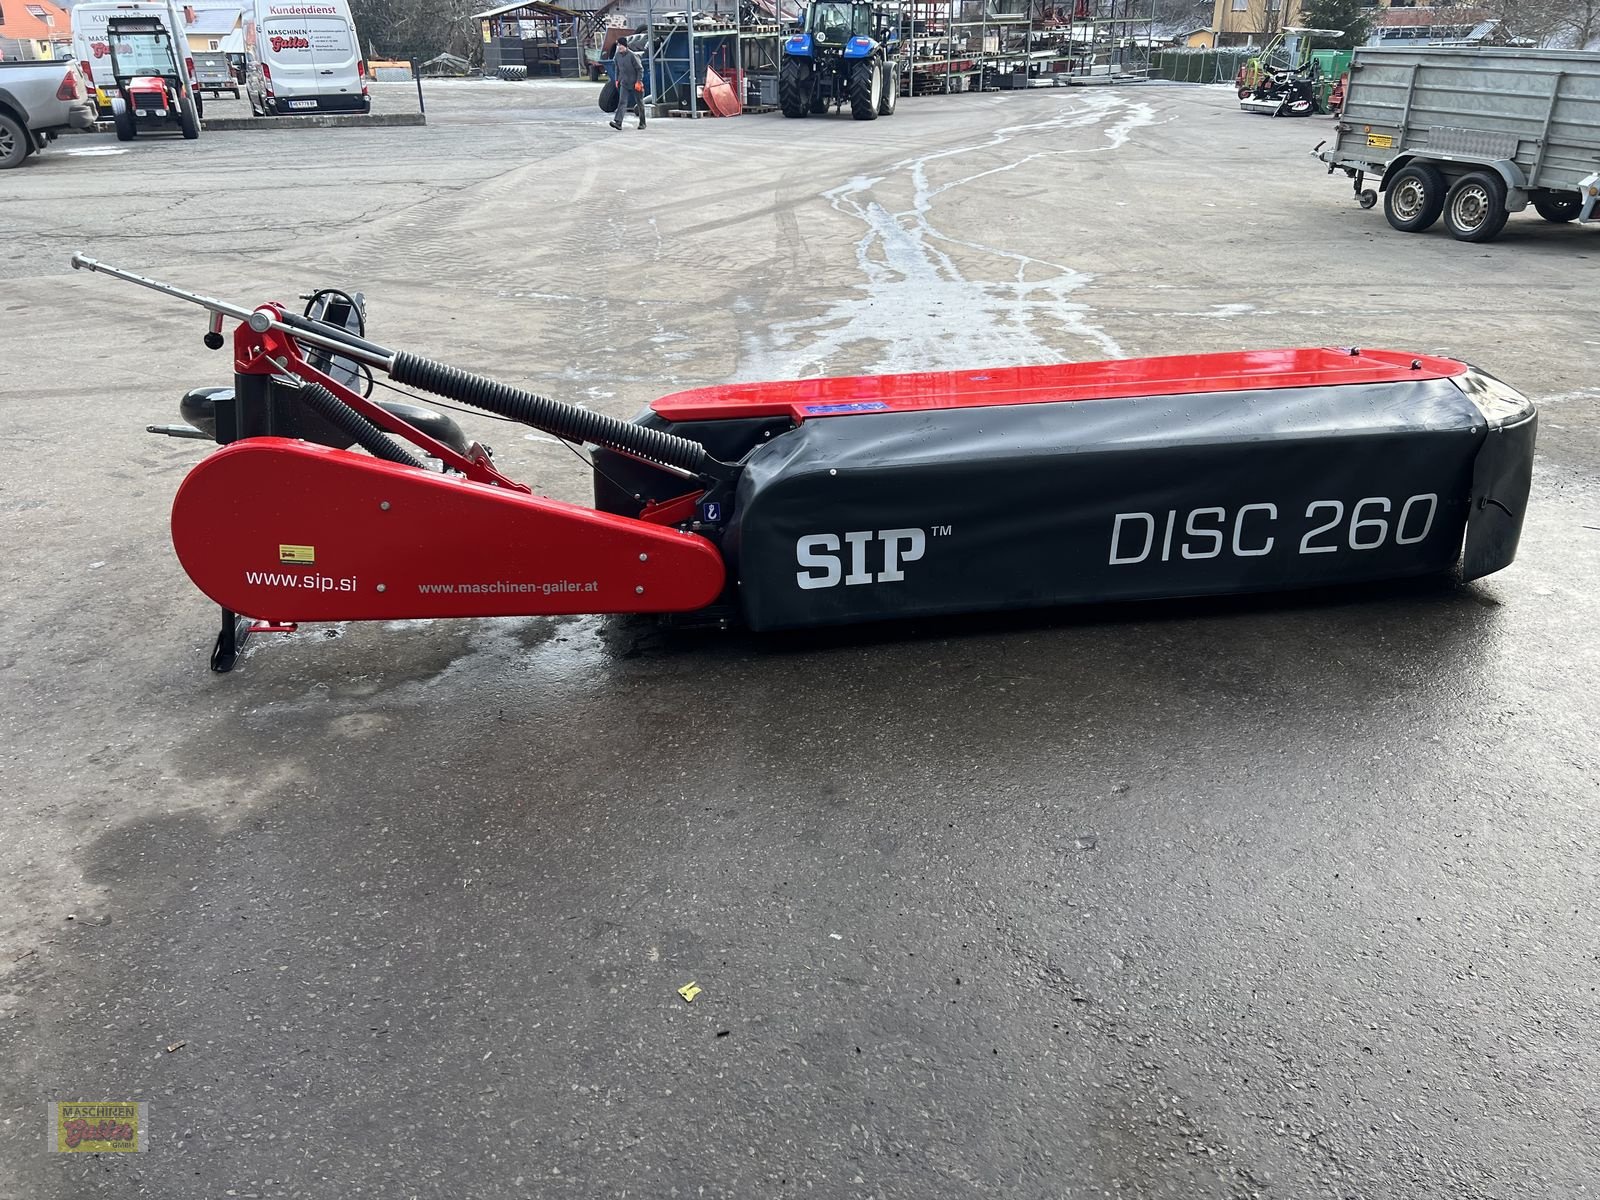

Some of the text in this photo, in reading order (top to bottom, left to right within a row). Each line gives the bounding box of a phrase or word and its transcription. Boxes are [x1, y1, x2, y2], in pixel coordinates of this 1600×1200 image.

[269, 5, 337, 15] Kundendienst
[1109, 492, 1438, 565] DISC 260
[796, 525, 953, 590] SIP TM
[246, 571, 358, 592] www.sip.si
[418, 580, 599, 595] www.maschinen-gailer.at
